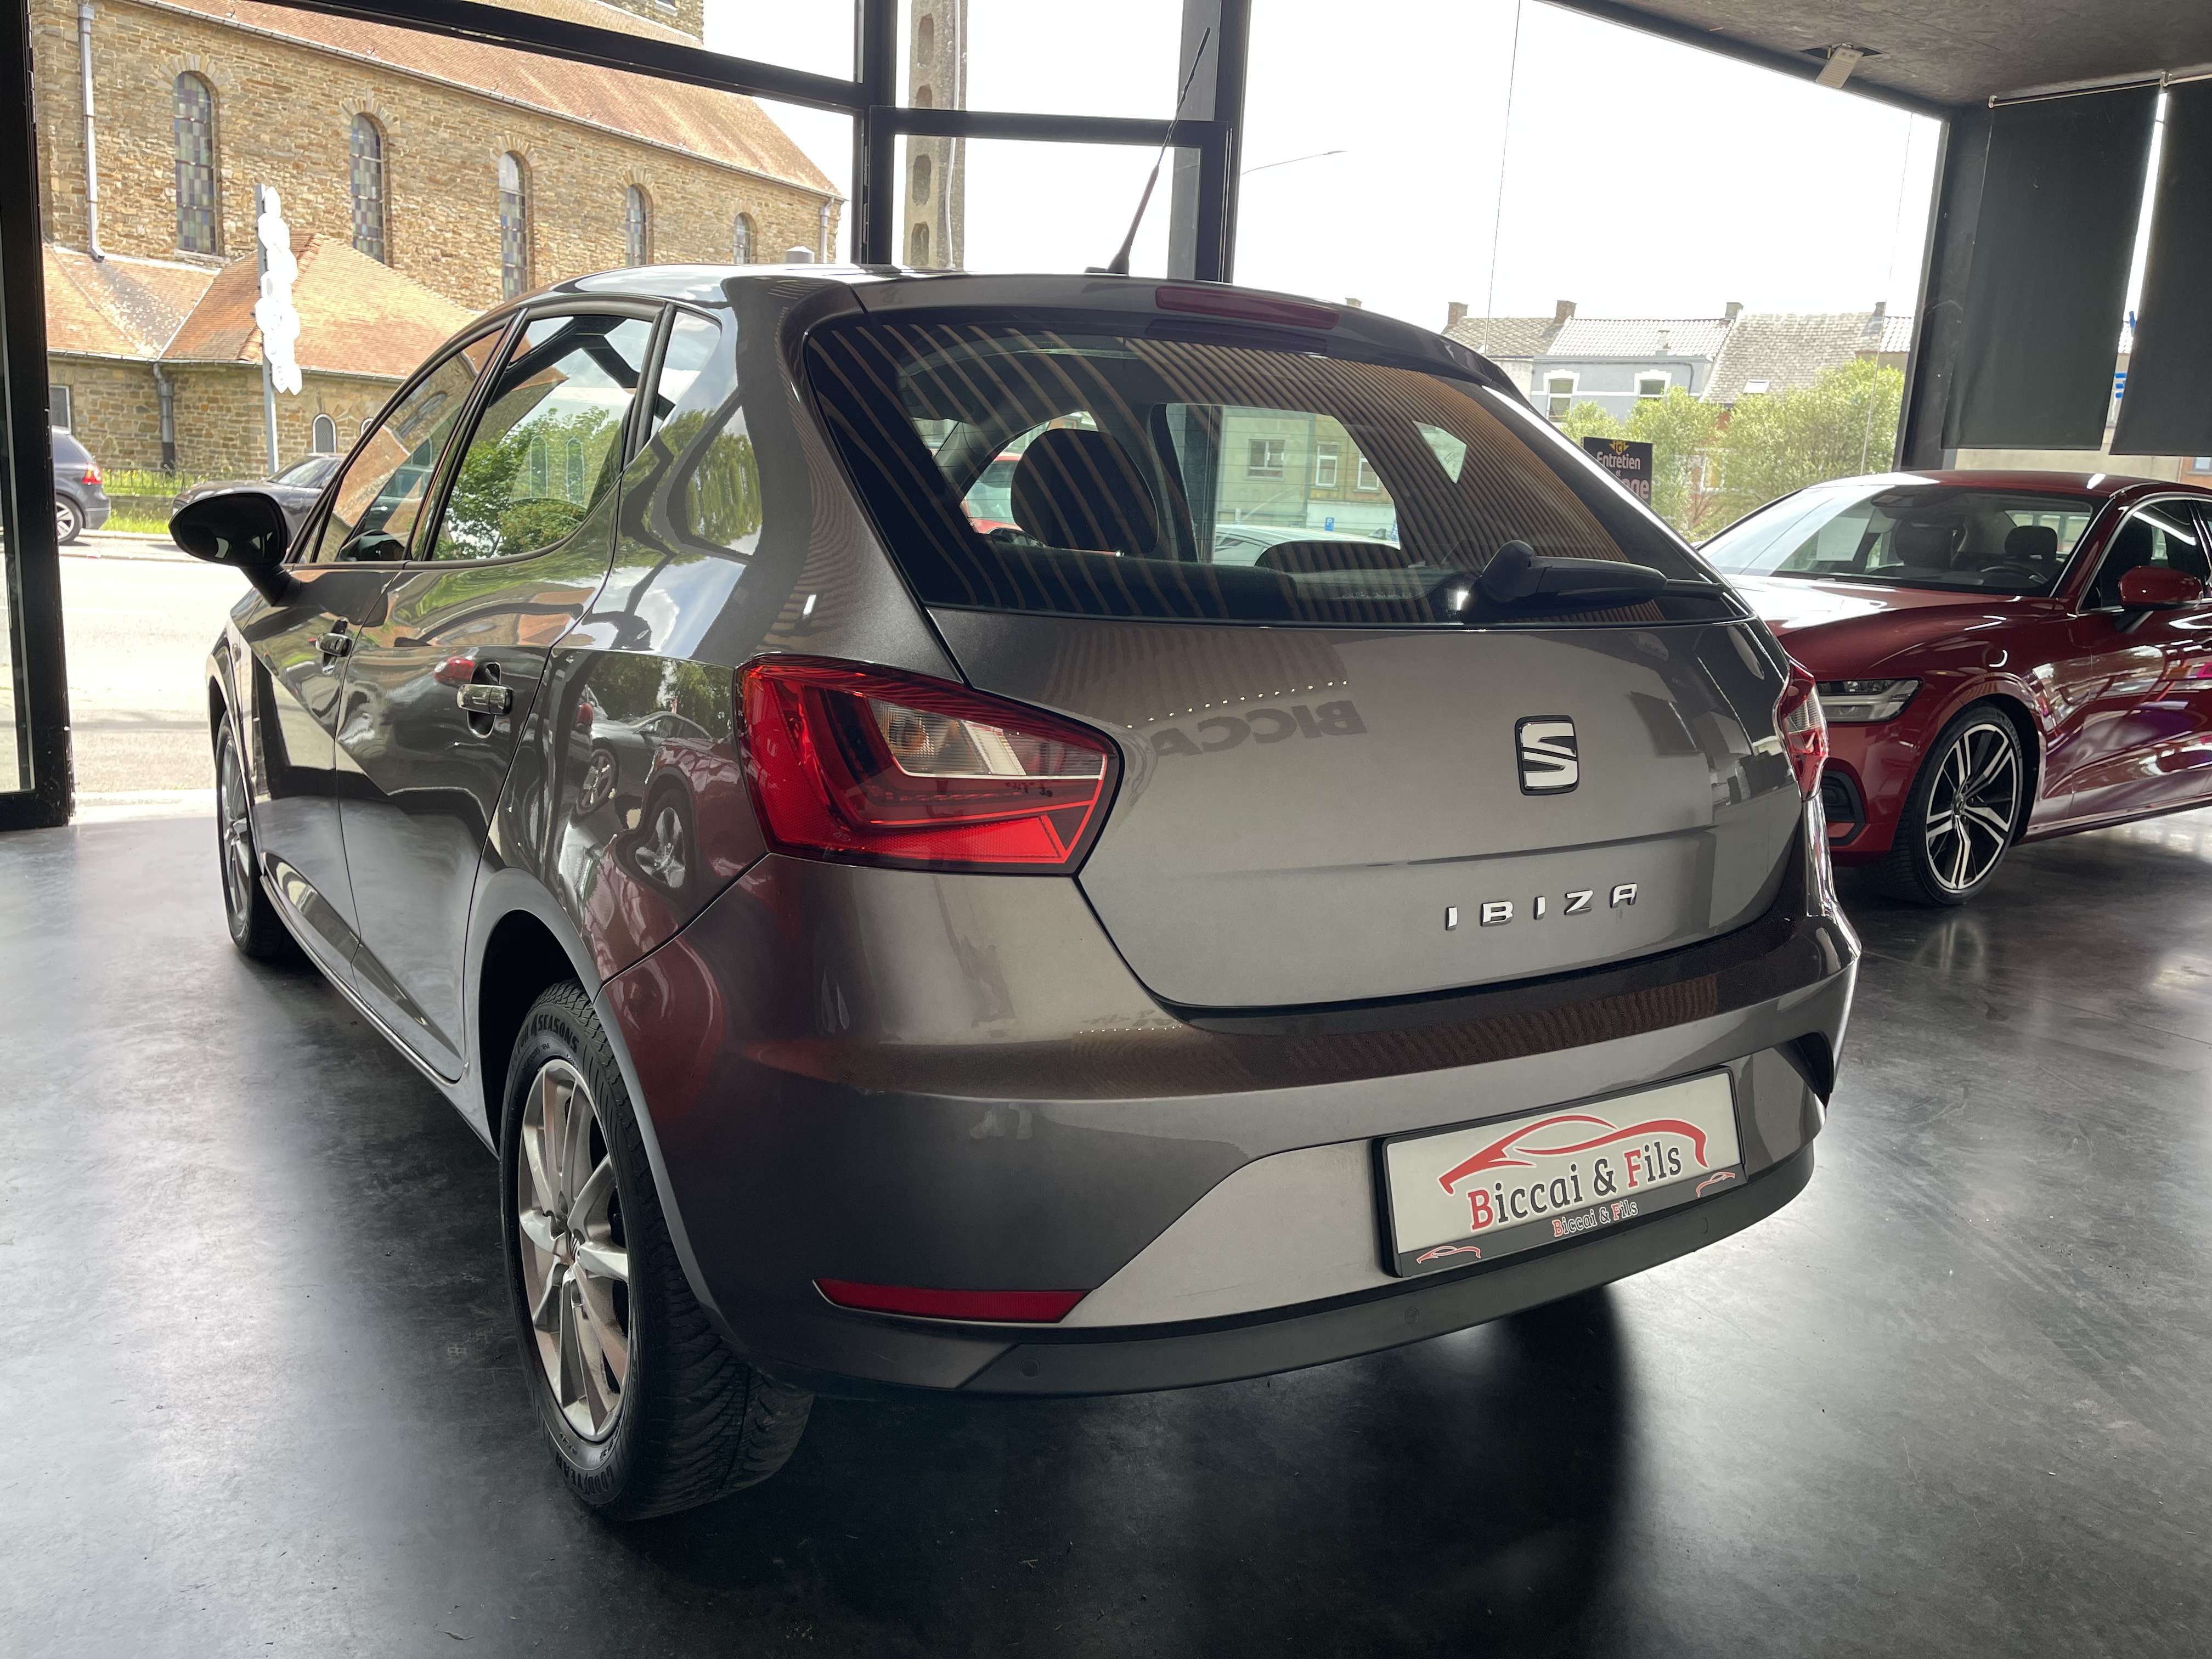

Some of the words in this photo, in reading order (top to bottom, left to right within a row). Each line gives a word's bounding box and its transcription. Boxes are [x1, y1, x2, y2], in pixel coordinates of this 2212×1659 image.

[1596, 451, 1641, 470] Entretien
[1445, 882, 1638, 931] IBIZA
[1468, 1164, 1583, 1231] Biccai
[1593, 1158, 1616, 1197] &
[1624, 1141, 1681, 1188] Fils
[1553, 1211, 1596, 1238] Biccai
[1599, 1206, 1611, 1224] &
[1611, 1199, 1638, 1221] Fils
